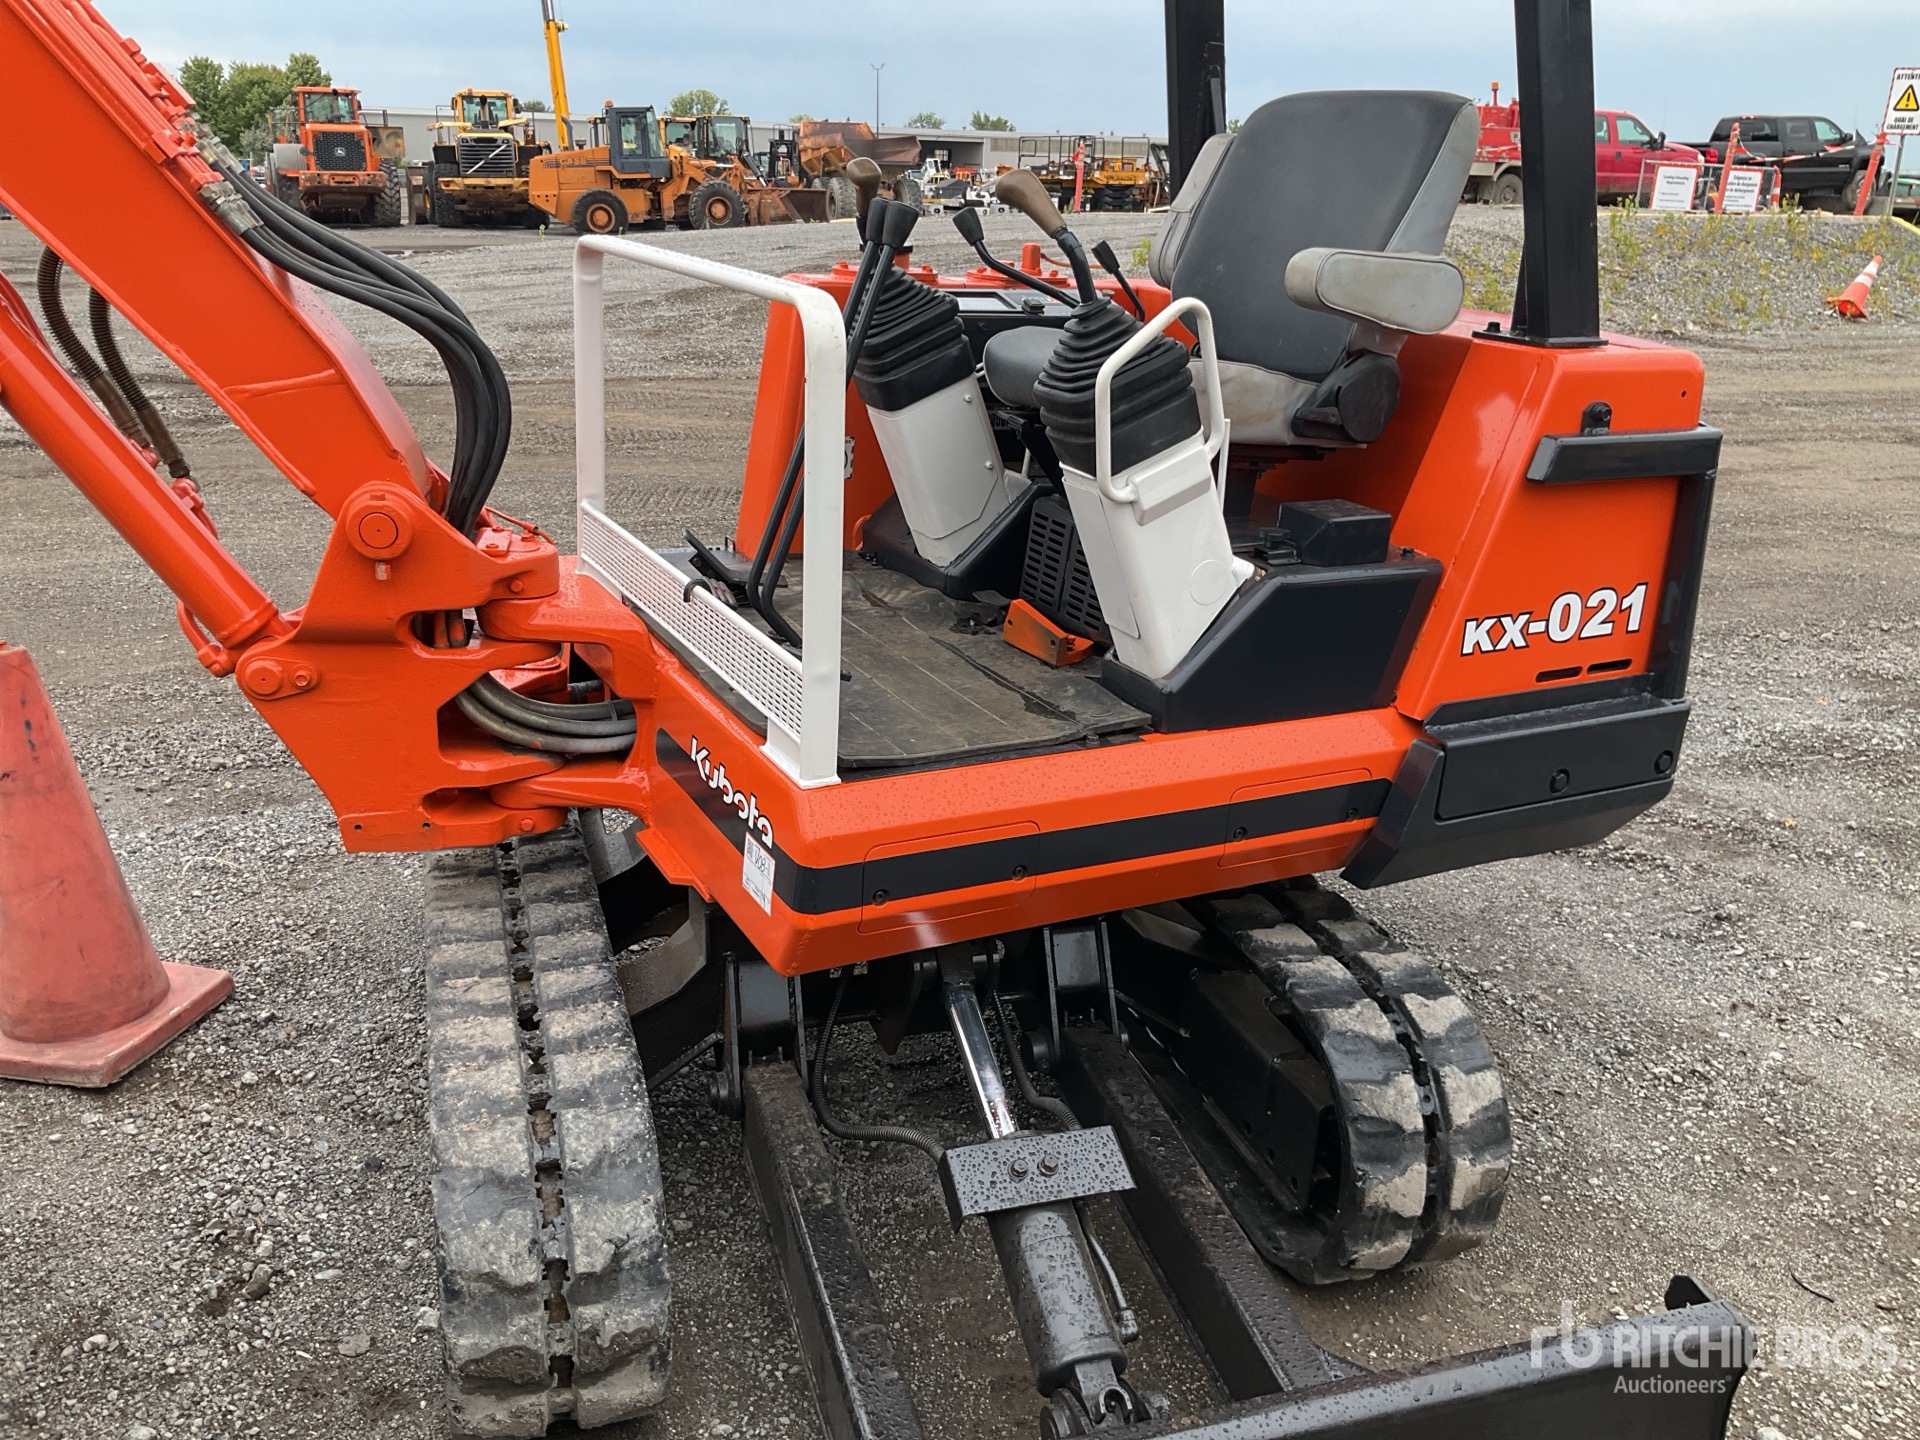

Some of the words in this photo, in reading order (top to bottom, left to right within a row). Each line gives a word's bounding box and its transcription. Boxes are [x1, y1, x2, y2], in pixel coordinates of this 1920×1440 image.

[559, 156, 588, 166] CASE
[1460, 582, 1649, 656] KX-021
[690, 734, 774, 849] Kubota
